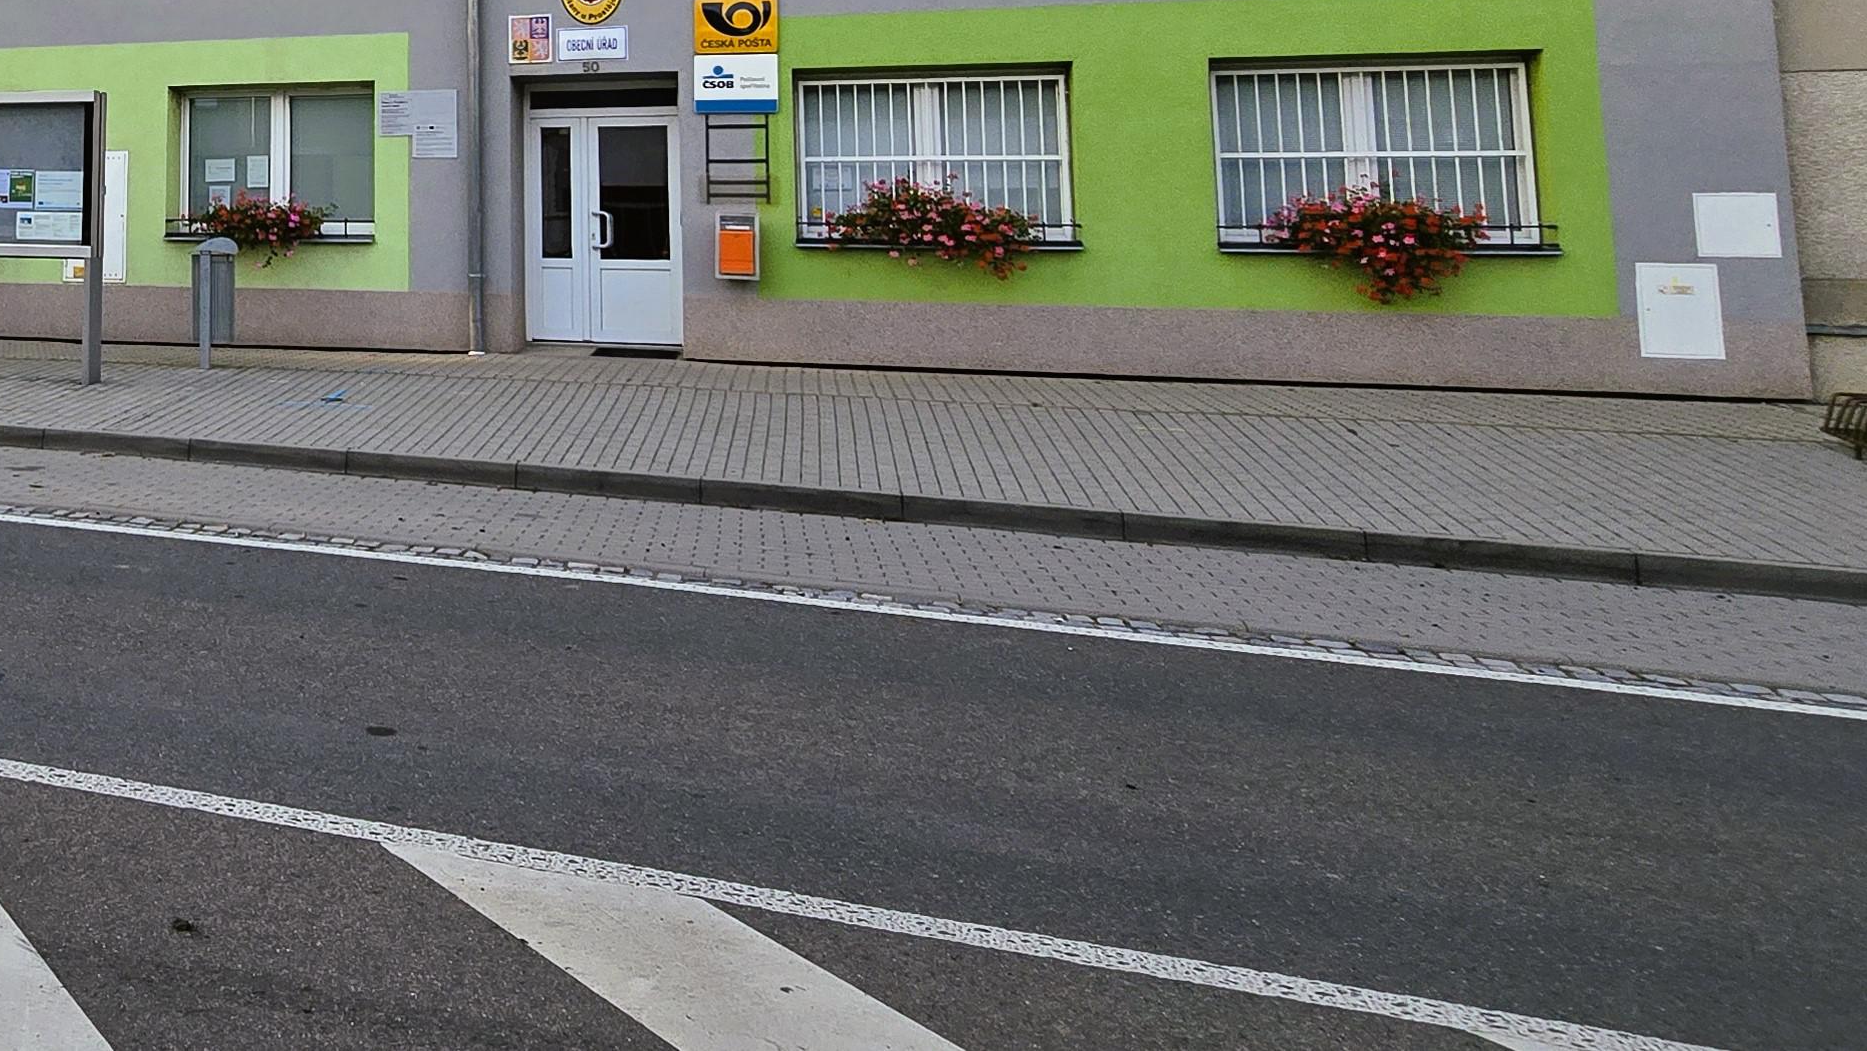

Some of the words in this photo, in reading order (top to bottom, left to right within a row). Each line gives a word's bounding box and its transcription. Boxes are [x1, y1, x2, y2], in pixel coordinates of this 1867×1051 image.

[566, 36, 594, 51] OBECNÍ
[597, 35, 618, 50] ÚŘAD
[700, 38, 735, 48] ČESKÁ
[738, 36, 772, 48] POŠTA
[582, 61, 600, 72] 50
[702, 80, 734, 89] ČSOB
